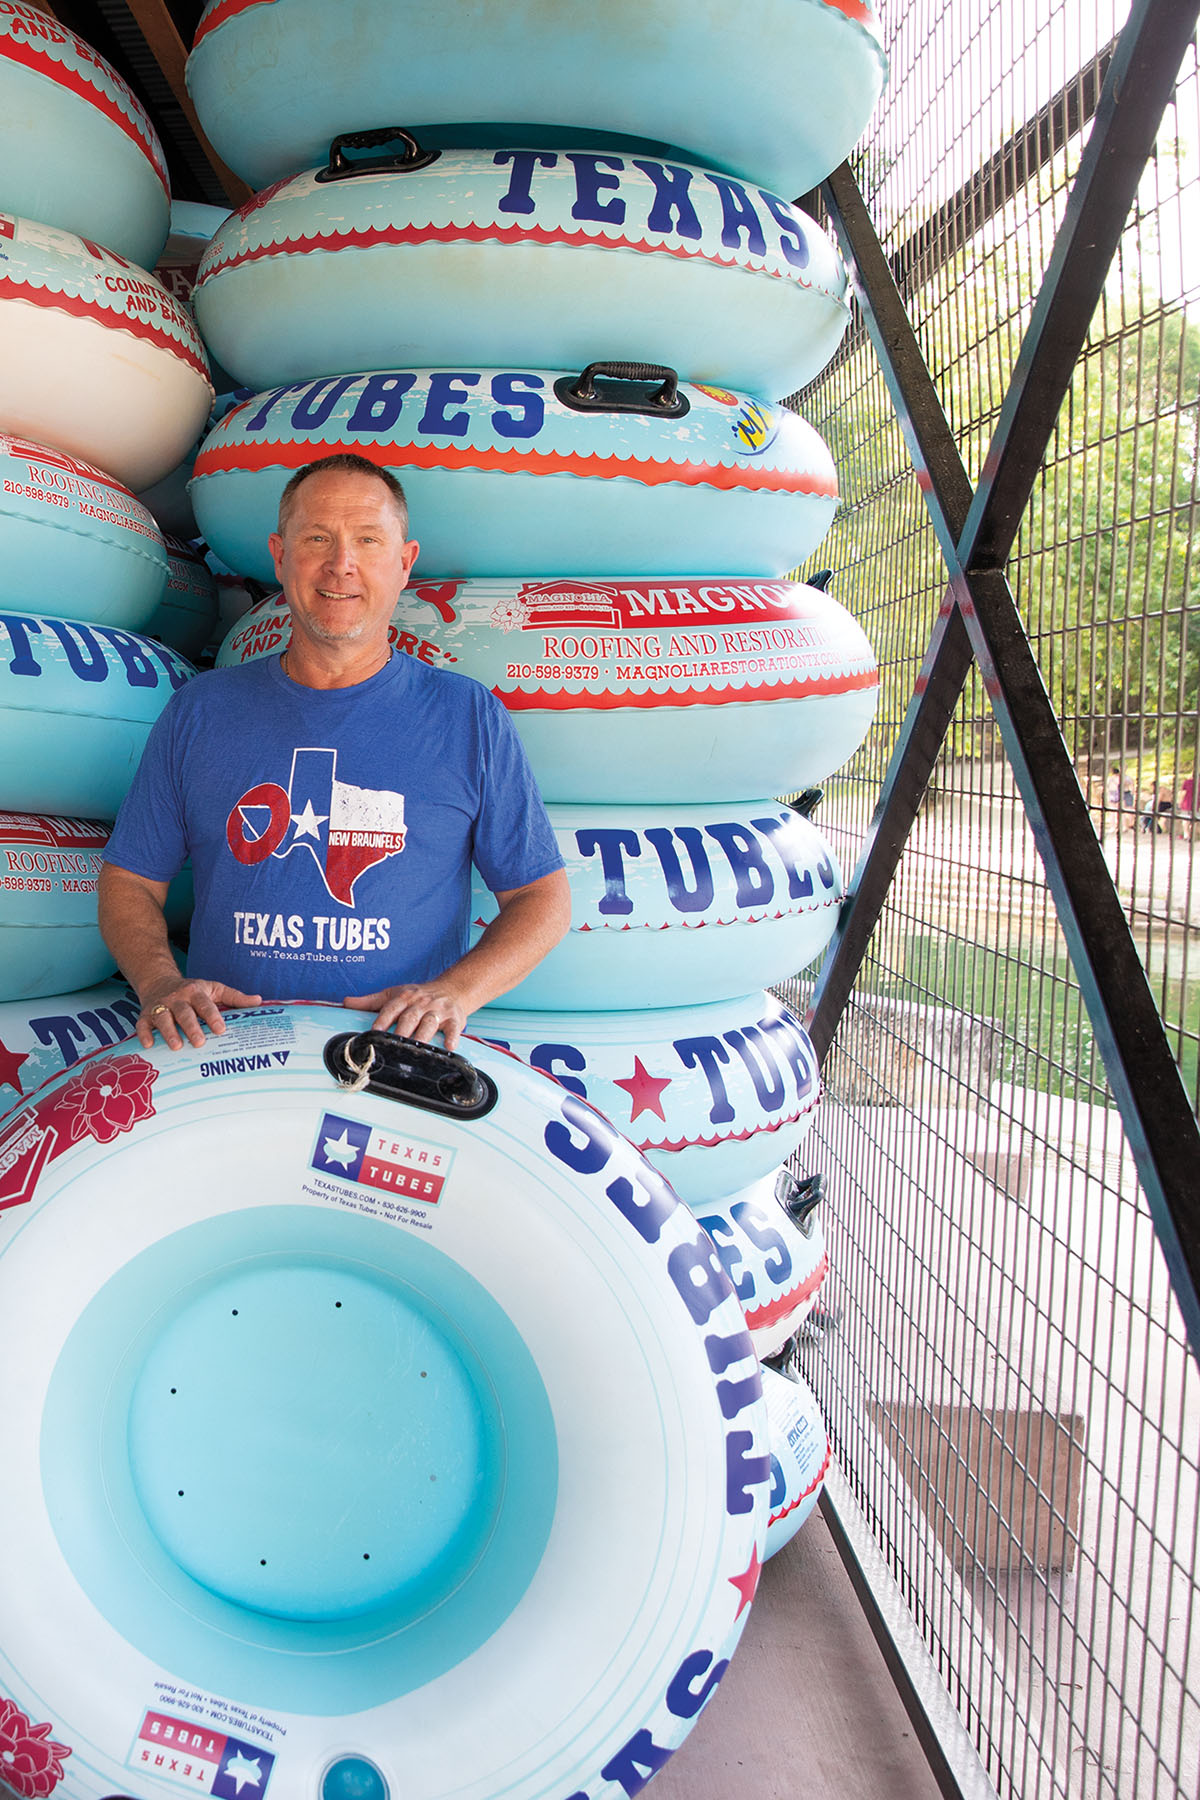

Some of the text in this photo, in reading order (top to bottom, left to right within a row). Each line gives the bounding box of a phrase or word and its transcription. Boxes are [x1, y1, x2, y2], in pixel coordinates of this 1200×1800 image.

[10, 17, 67, 43] AND
[492, 150, 810, 270] TEXAS
[126, 294, 157, 313] AND
[245, 371, 546, 439] TUBES
[3, 480, 71, 510] 210-598-9379
[26, 464, 104, 504] ROOFING
[105, 491, 131, 515] AND
[241, 633, 284, 663] AND
[543, 635, 661, 660] ROOFING
[668, 633, 719, 658] AND
[506, 664, 600, 680] 210-598-9379
[329, 831, 402, 850] NEW BRAUNFELS
[5, 851, 89, 875] ROOFING
[233, 911, 391, 951] TEXAS TUBES
[250, 949, 366, 963] www.TexasTubes.com
[200, 1054, 272, 1078] WARNING
[377, 1138, 442, 1167] TEXAS
[369, 1166, 434, 1195] TUBES
[301, 1184, 330, 1202] Property
[339, 1197, 357, 1210] Texas
[358, 1202, 378, 1216] Tubes
[384, 1211, 397, 1222] Not
[397, 1214, 409, 1225] For
[409, 1218, 433, 1231] Resale
[313, 1178, 427, 1220] TEXASTUBES.COM 830-626-9900
[177, 1687, 190, 1699] For
[191, 1692, 202, 1702] Not
[210, 1698, 229, 1710] Tubes
[230, 1705, 249, 1718] Texas
[150, 1721, 215, 1753] TUBES
[210, 1710, 274, 1742] TEXASTUBES.COM
[257, 1716, 287, 1736] Property
[141, 1750, 205, 1781] TEXAS
